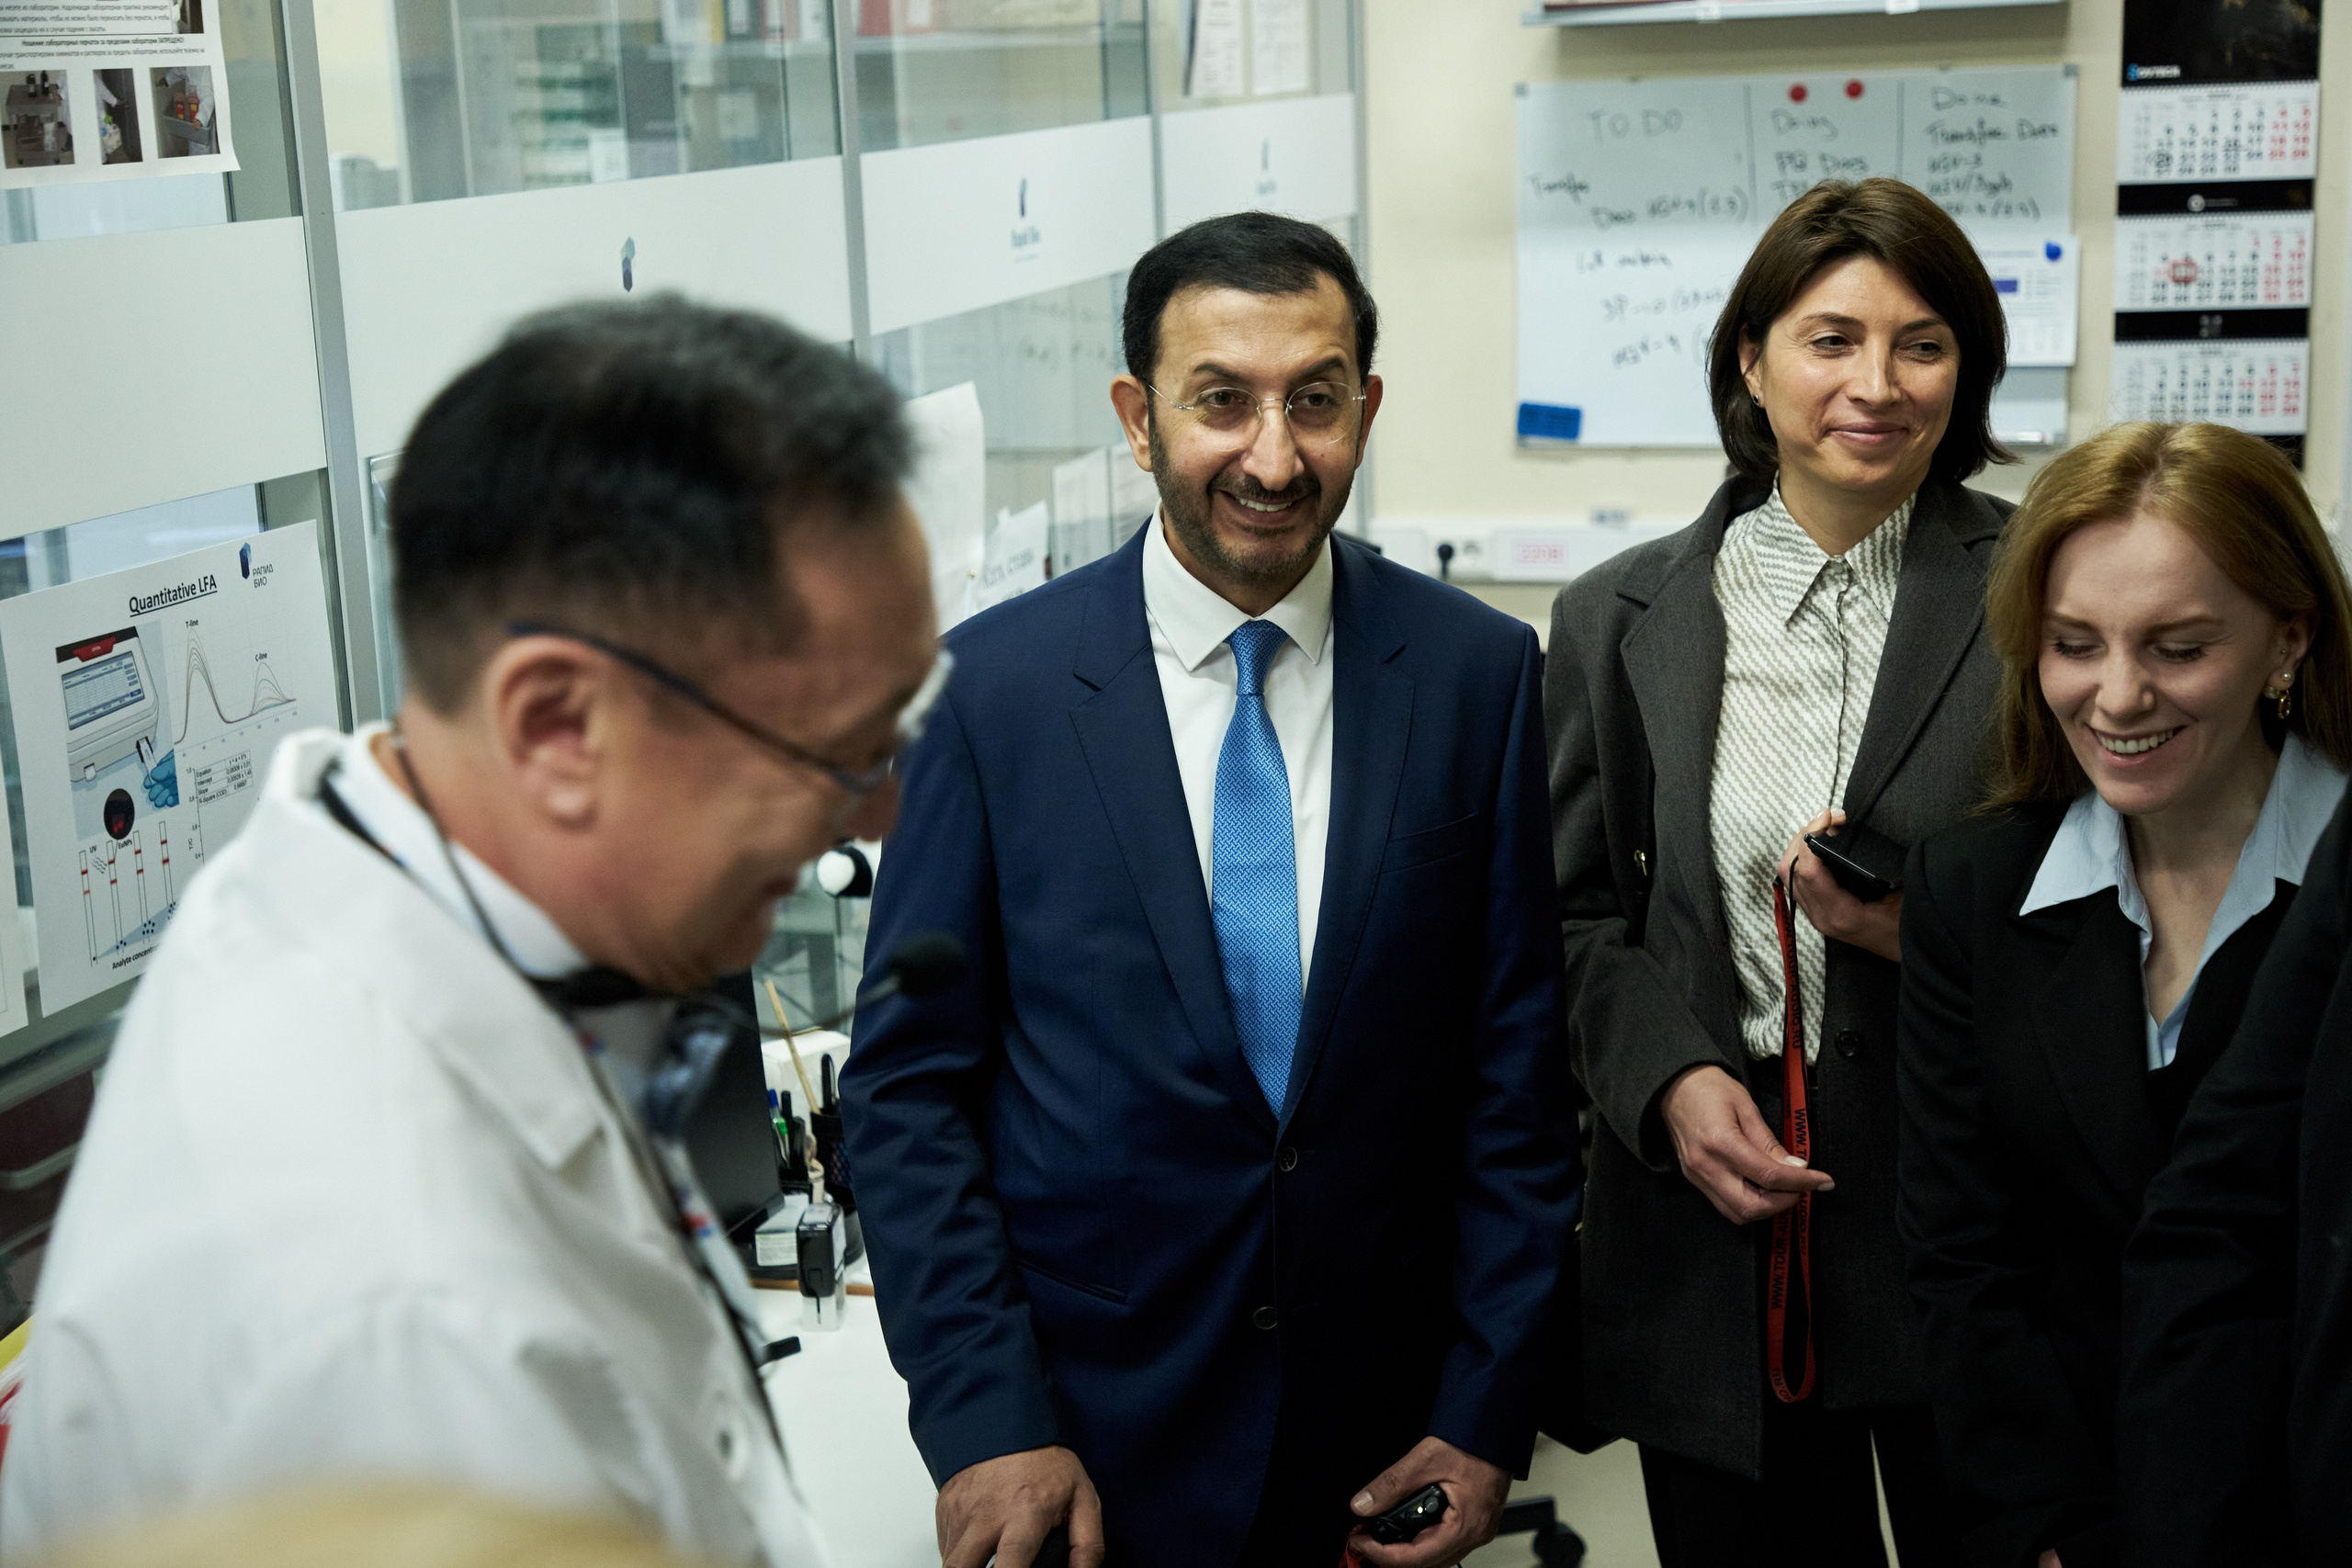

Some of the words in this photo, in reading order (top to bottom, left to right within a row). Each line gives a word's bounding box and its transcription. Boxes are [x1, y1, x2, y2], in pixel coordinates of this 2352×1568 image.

[1586, 108, 1630, 142] TO
[1641, 107, 1683, 137] DO
[253, 564, 274, 578] РАПИД
[254, 576, 267, 589] БИО
[129, 582, 197, 614] Quantitative
[198, 574, 218, 594] LFA
[186, 619, 198, 628] T-line
[254, 652, 267, 661] C-line
[196, 768, 212, 778] Equation
[89, 845, 97, 853] UV
[119, 839, 133, 850] EuNPs
[112, 955, 132, 970] Analyte
[131, 943, 159, 961] concentr
[1771, 1206, 1789, 1310] WWW.TOUR-AU
